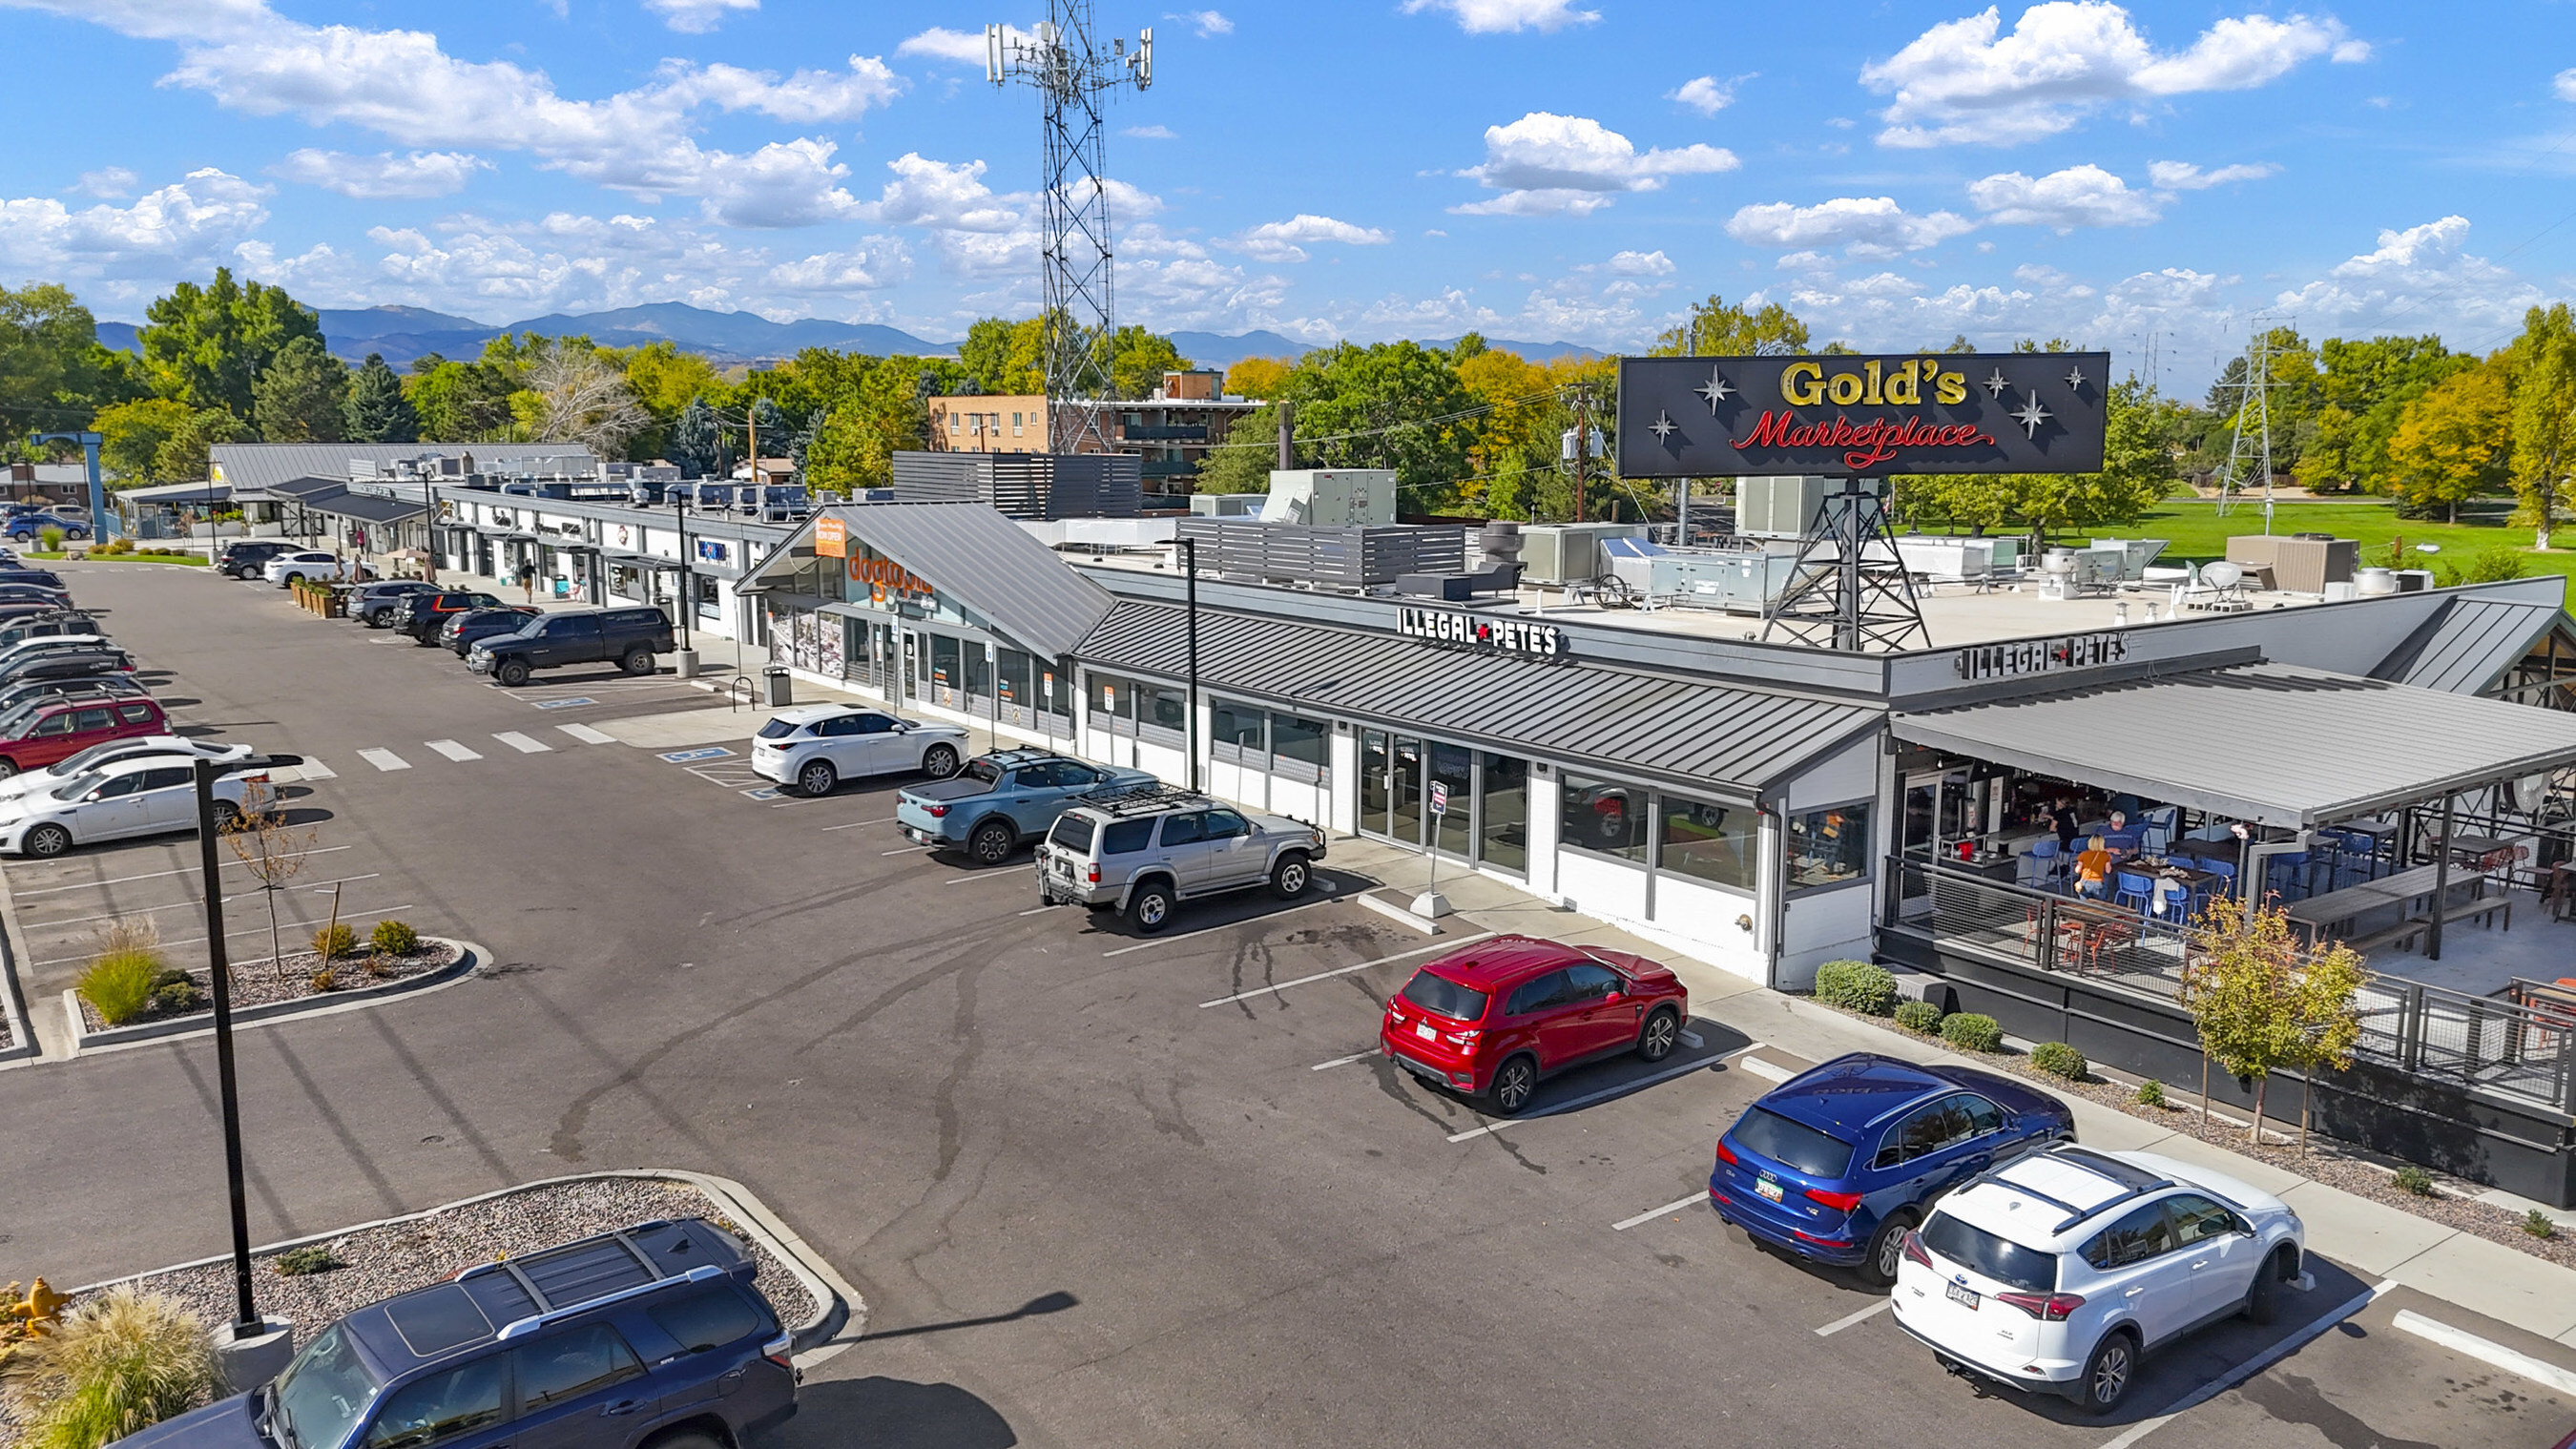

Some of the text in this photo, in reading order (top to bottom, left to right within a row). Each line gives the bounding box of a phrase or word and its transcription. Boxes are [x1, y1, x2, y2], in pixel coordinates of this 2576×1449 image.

[1780, 359, 1967, 406] Gold's
[1728, 410, 1995, 469] Marketplace
[1397, 607, 1557, 655] ILLEGAL PETE'S
[1965, 631, 2131, 680] ILLEGAL PETE'S
